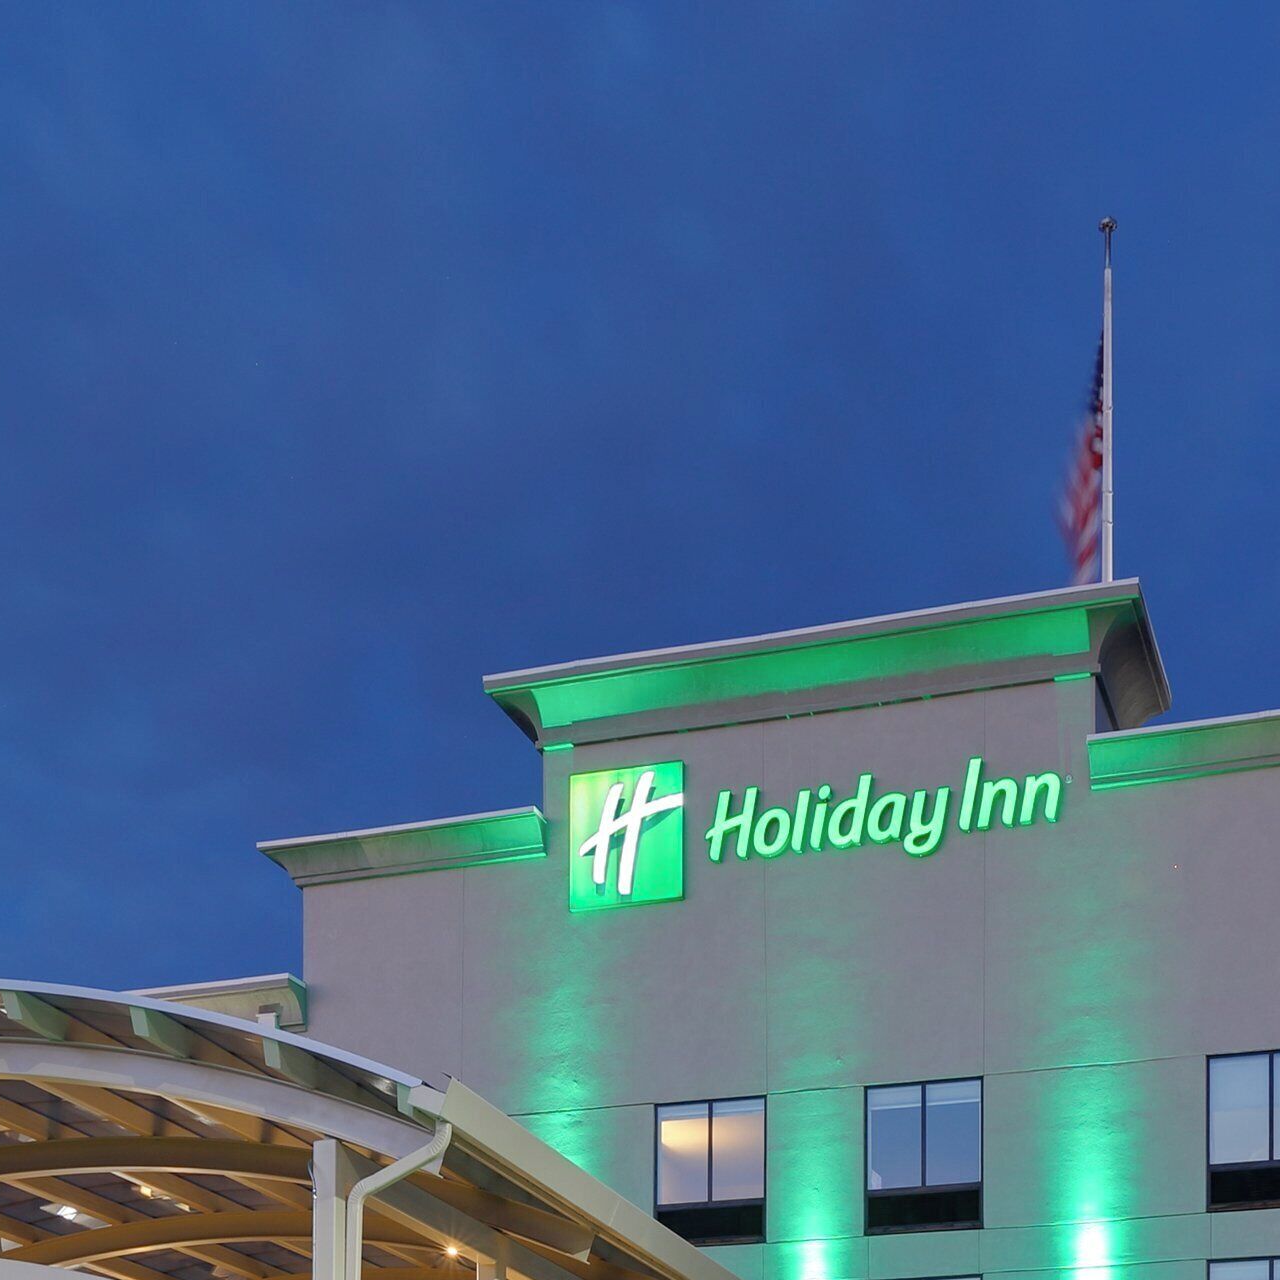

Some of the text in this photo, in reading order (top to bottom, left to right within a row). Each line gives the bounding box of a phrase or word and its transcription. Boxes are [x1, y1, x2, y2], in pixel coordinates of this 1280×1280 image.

[579, 770, 684, 895] H
[705, 756, 1063, 863] Holiday Inn
